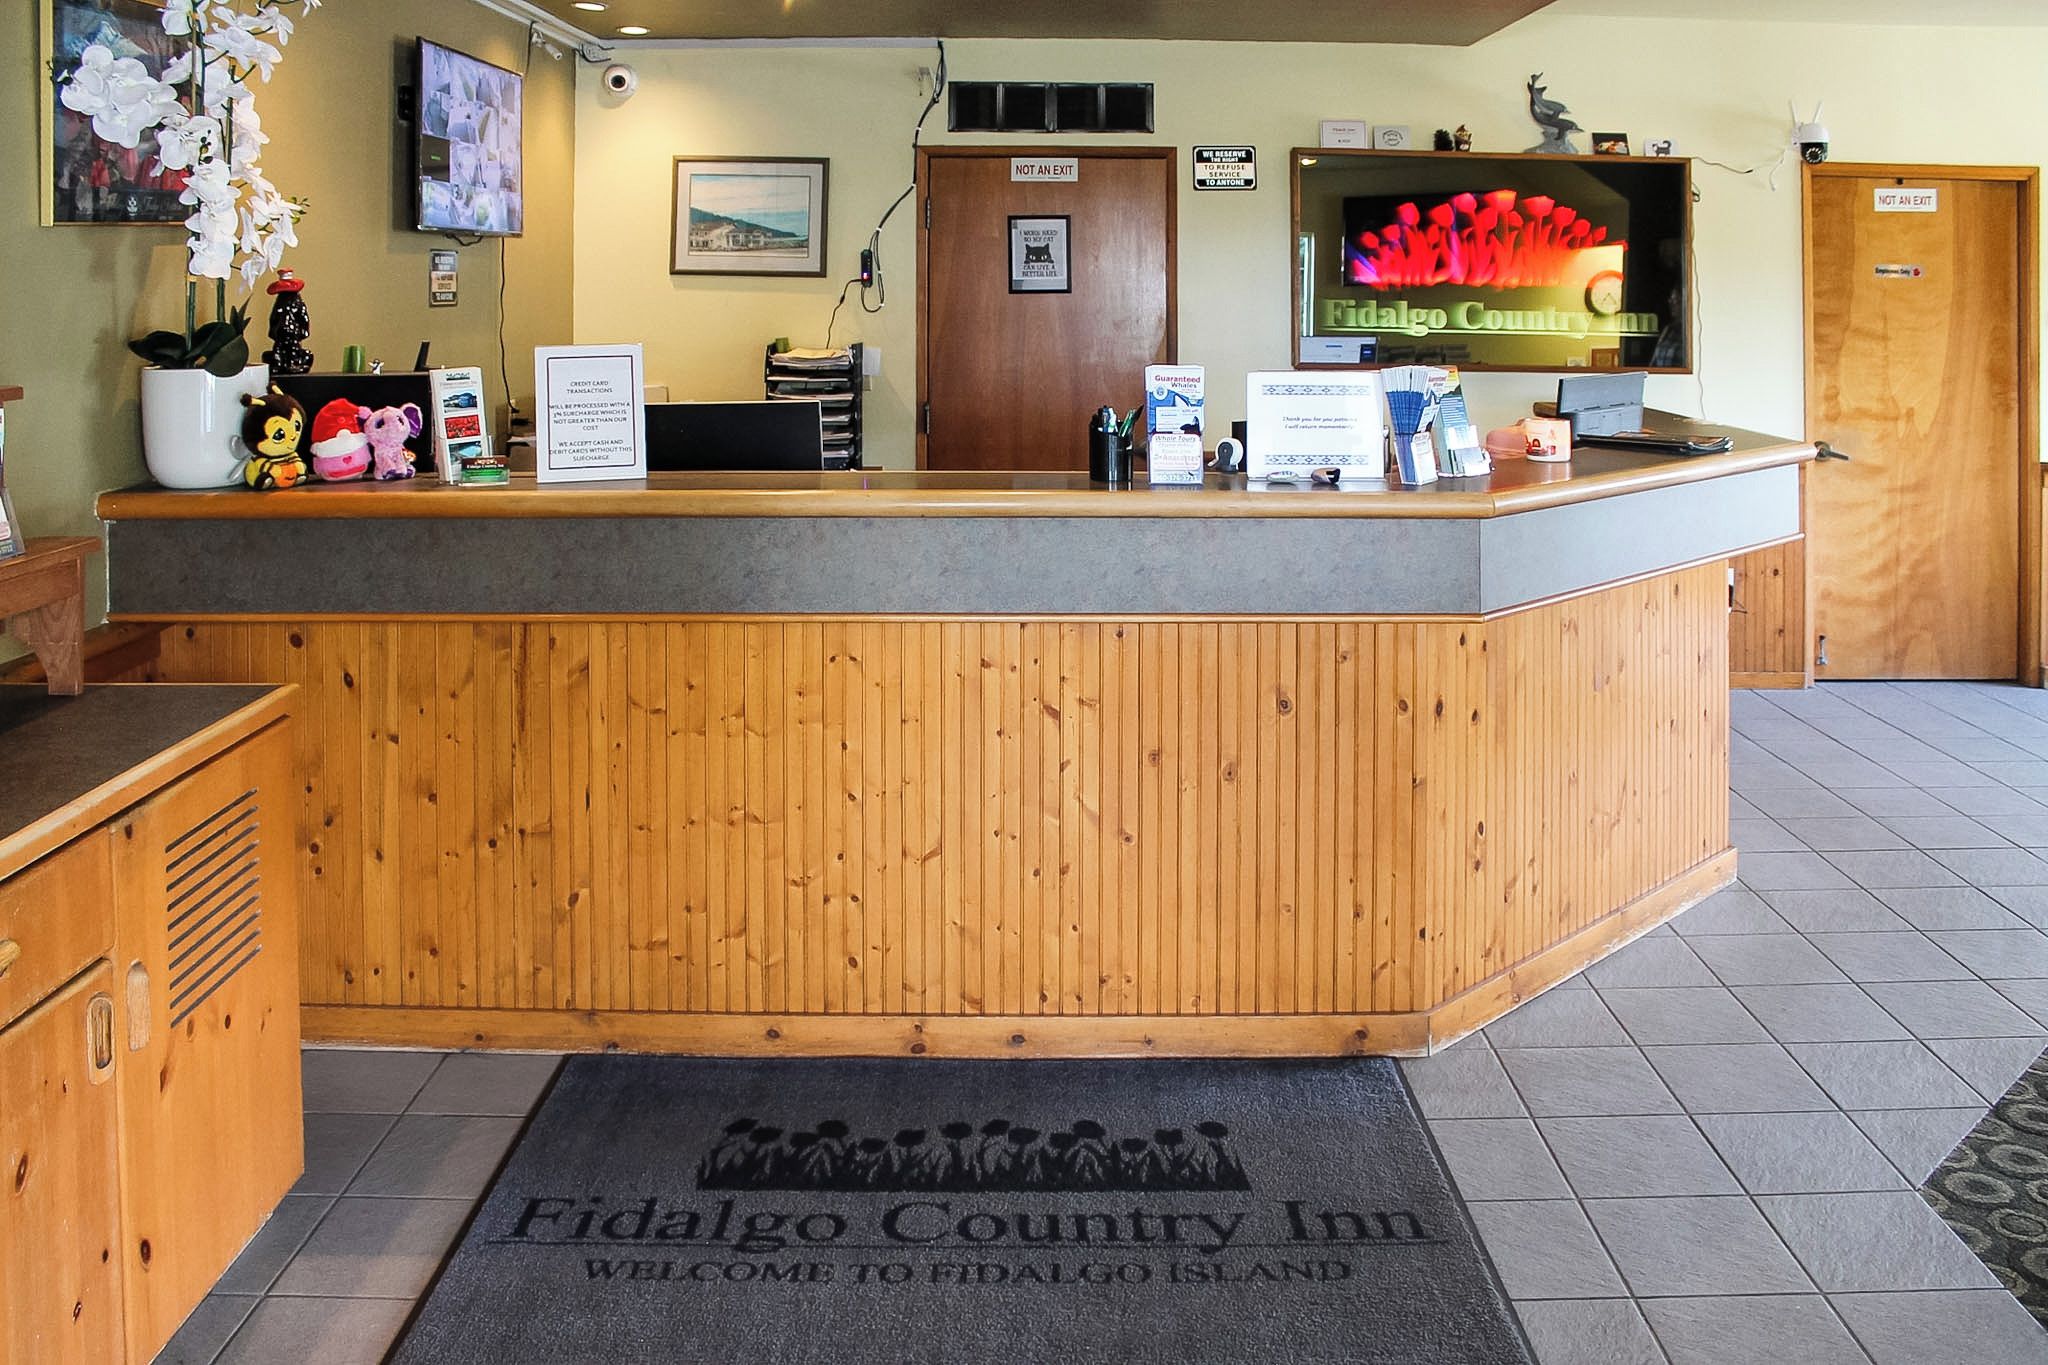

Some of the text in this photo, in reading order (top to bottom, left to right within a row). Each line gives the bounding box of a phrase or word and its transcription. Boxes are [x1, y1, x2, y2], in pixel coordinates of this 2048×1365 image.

[1202, 150, 1246, 158] WE RESERVE
[1016, 164, 1074, 175] NOT AN EXIT
[1879, 195, 1932, 205] NOT AN EXIT
[1323, 299, 1448, 337] Fidalgo
[1455, 301, 1595, 339] Country
[1155, 375, 1201, 383] Guaranteed
[508, 1197, 1433, 1253] Fidalgo Country Inn
[584, 1258, 1352, 1285] WELCOME TO FIDALGO ISLAND
